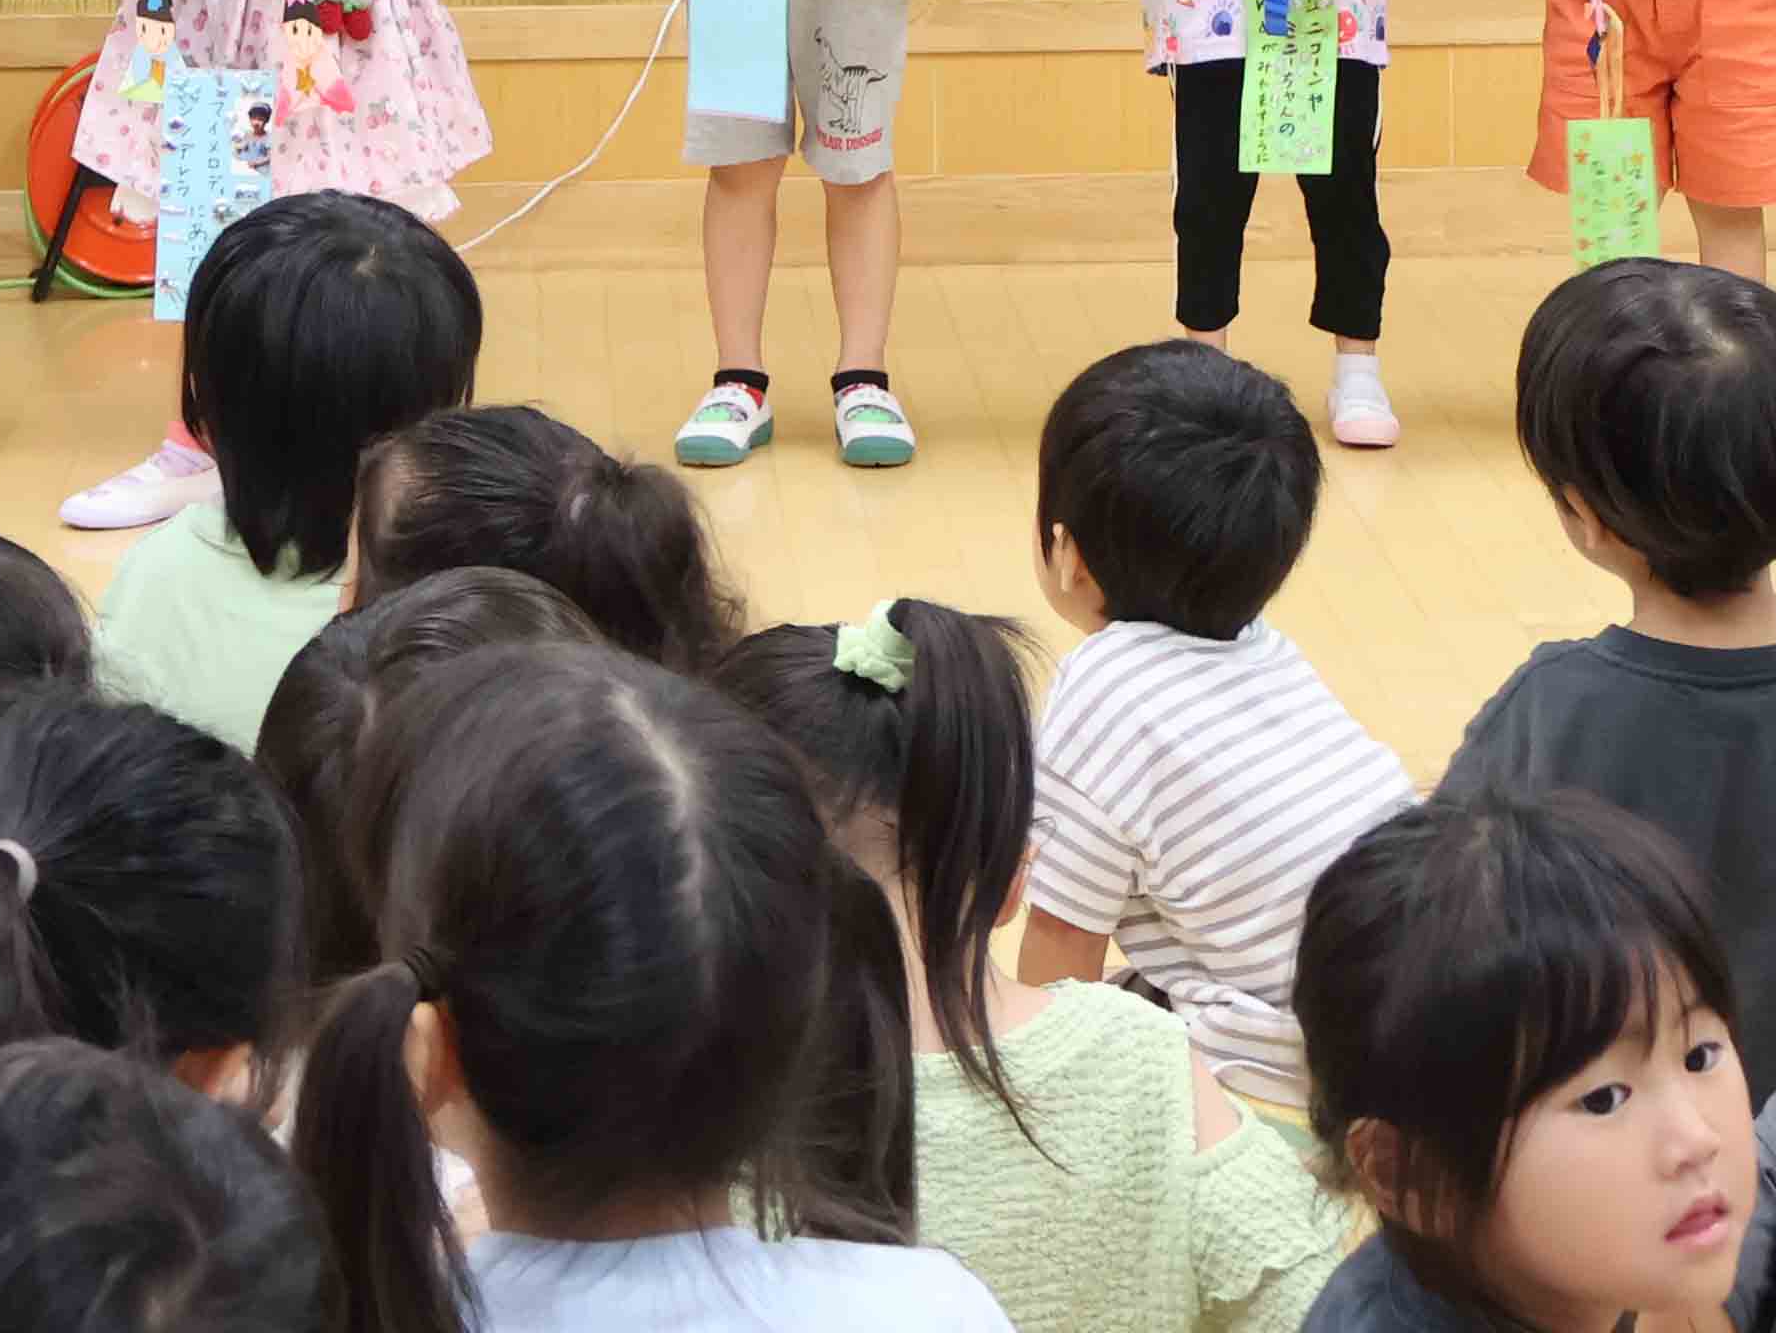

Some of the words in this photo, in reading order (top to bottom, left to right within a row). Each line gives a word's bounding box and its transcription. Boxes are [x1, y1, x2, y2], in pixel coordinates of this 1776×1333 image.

[208, 101, 225, 196] マイメロディ
